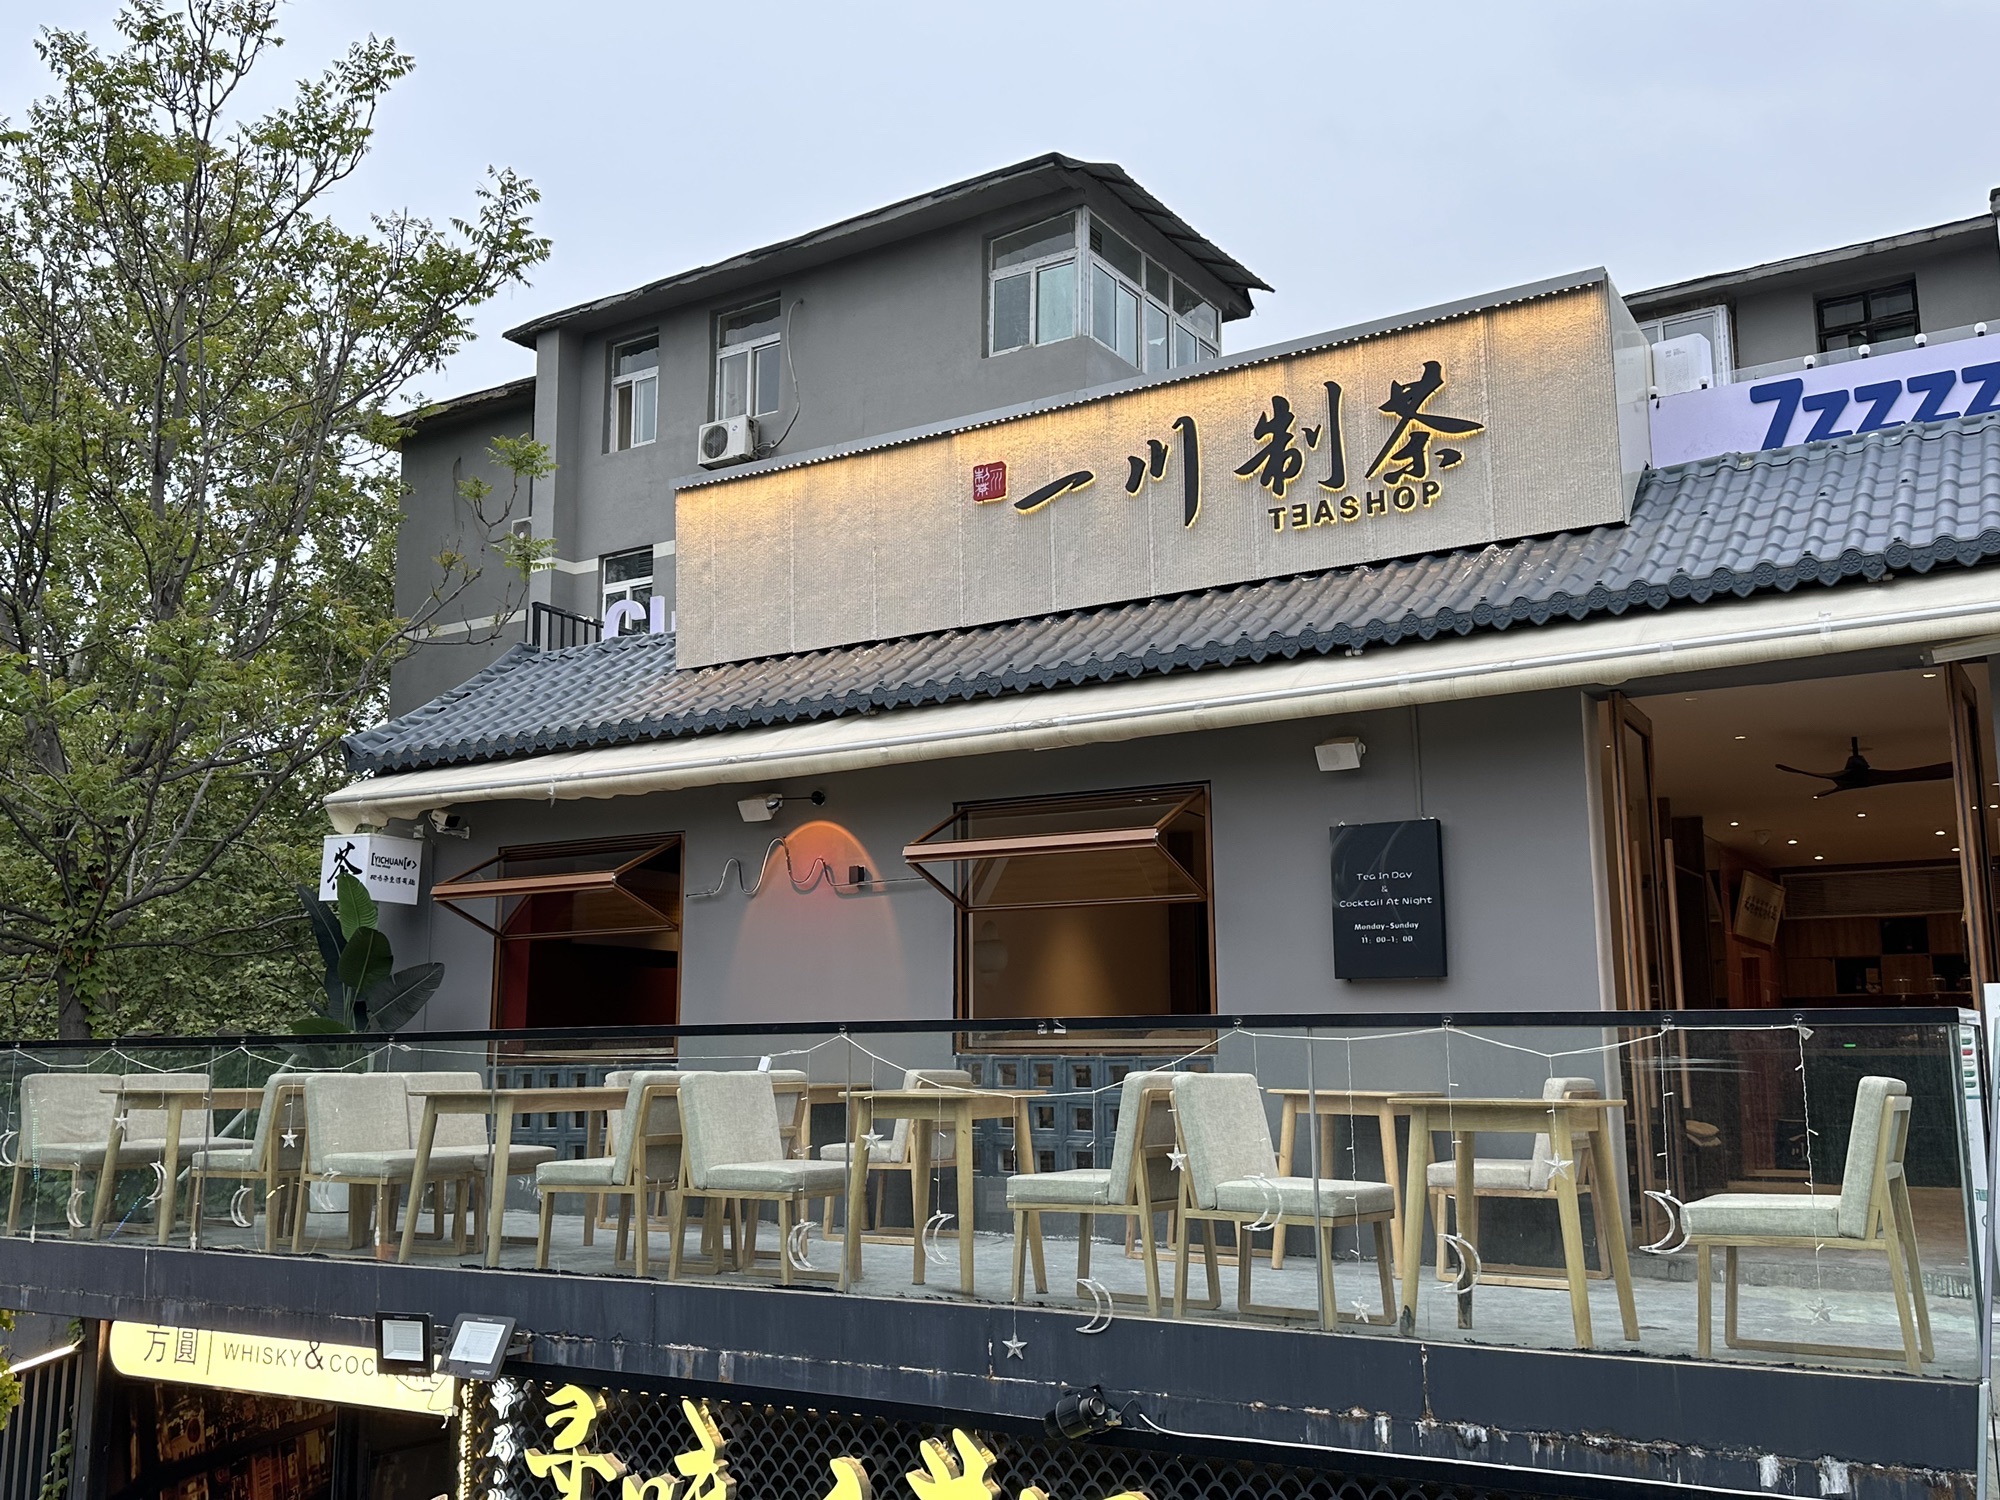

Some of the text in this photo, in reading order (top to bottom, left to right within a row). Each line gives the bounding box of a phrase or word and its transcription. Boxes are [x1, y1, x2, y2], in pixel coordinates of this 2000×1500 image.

[1014, 361, 1485, 528] 一川制茶
[1391, 871, 1413, 879] Day
[1339, 899, 1383, 908] Cocktail
[1402, 897, 1432, 906] Night
[1354, 921, 1419, 931] Monday-Sunday
[143, 1325, 198, 1365] 方圓
